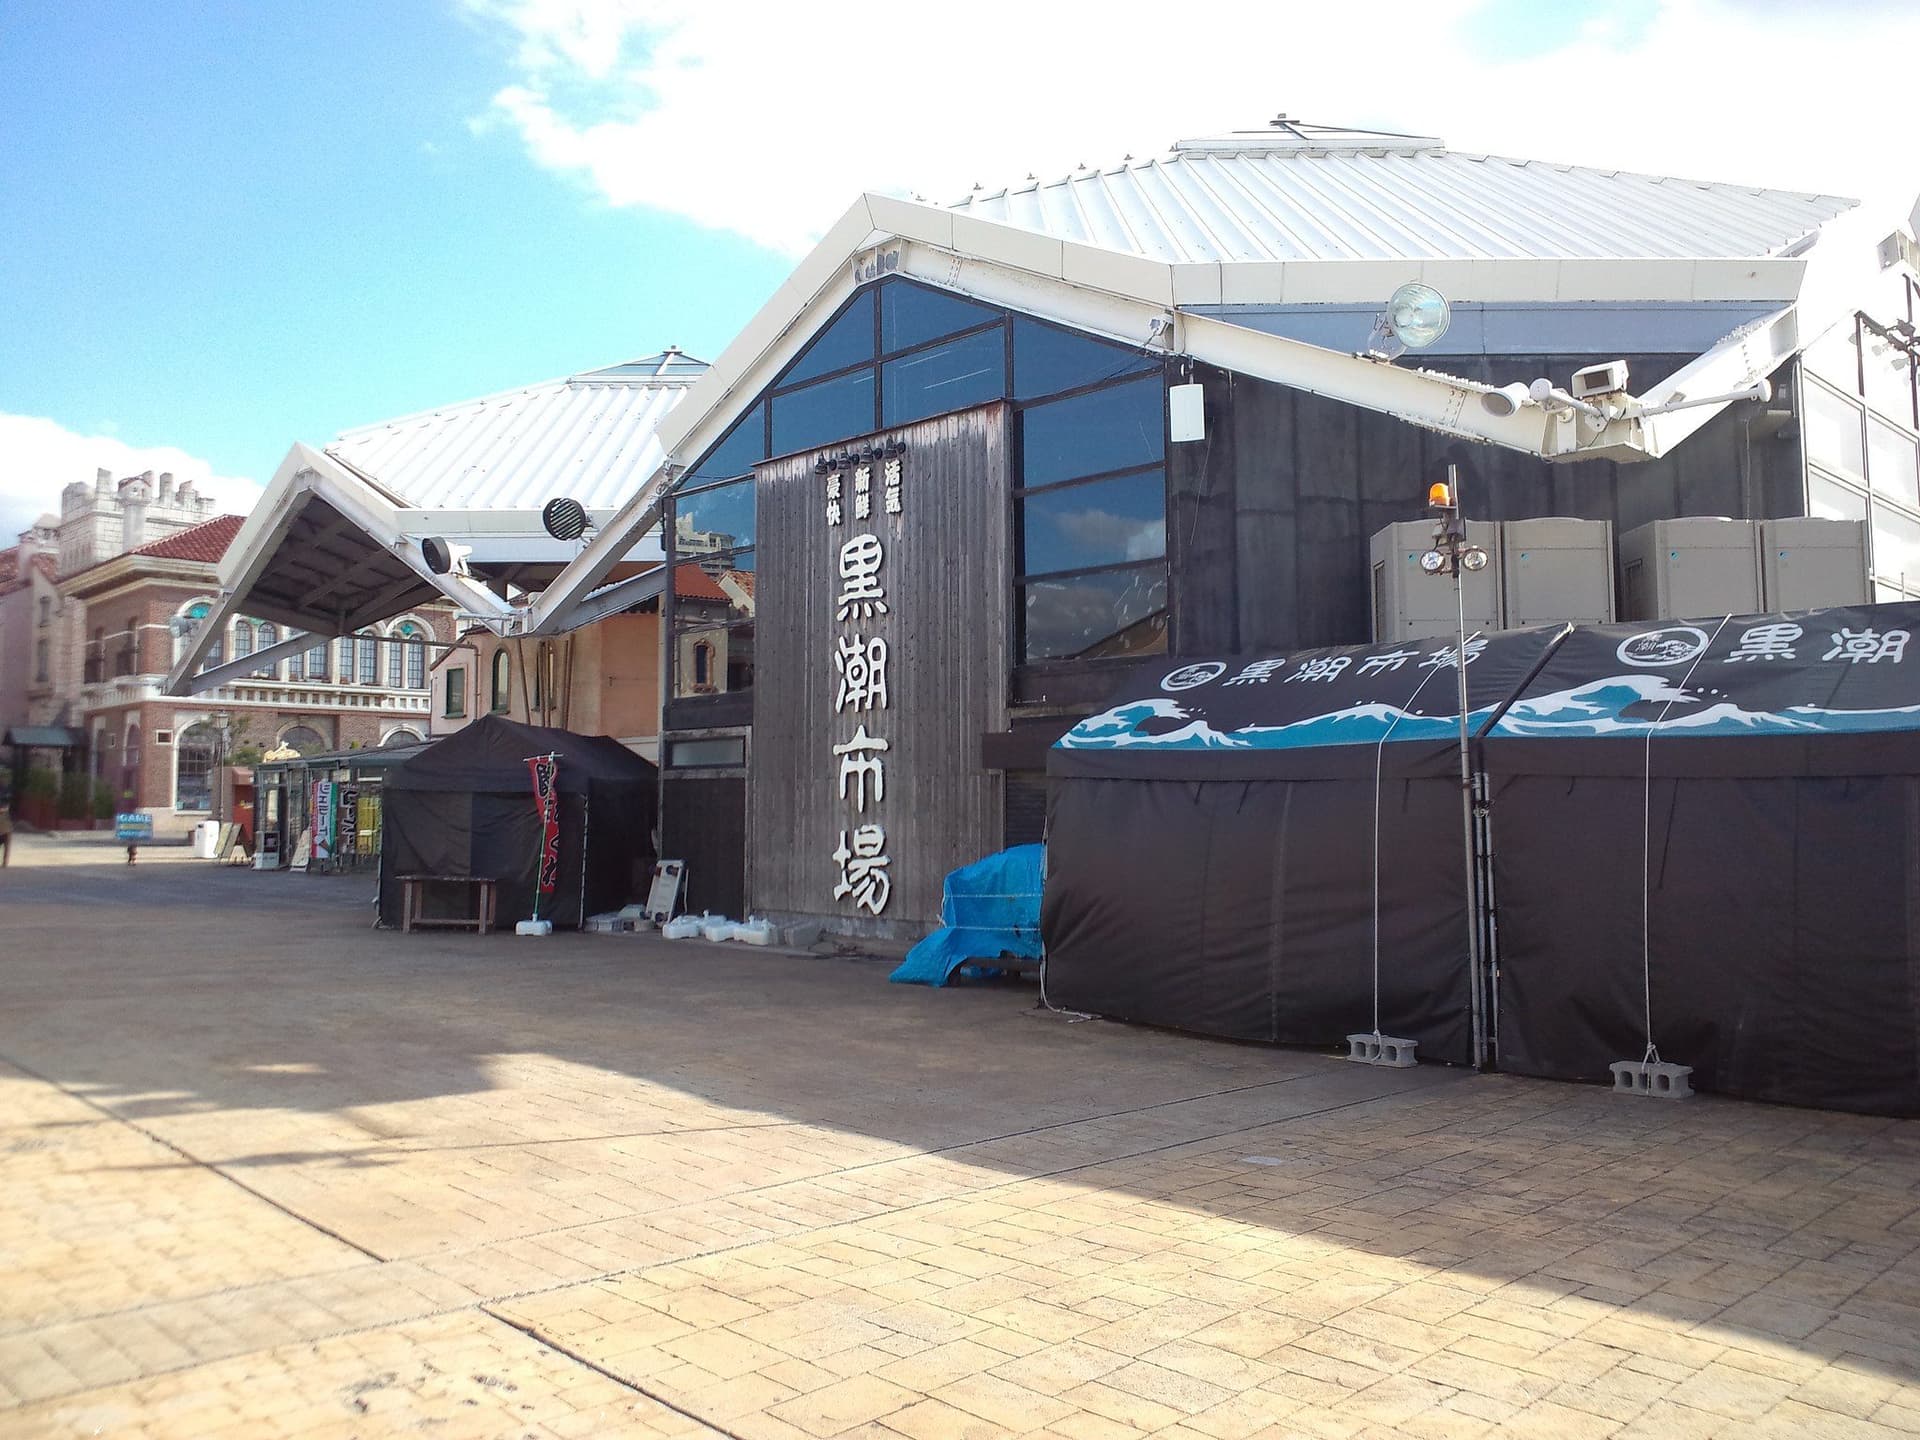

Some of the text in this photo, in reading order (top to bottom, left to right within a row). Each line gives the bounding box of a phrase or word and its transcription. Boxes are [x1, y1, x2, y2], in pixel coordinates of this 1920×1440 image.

[1222, 639, 1490, 687] 黒潮市場
[1723, 622, 1911, 664] 黒潮
[832, 533, 891, 915] 黒潮市場
